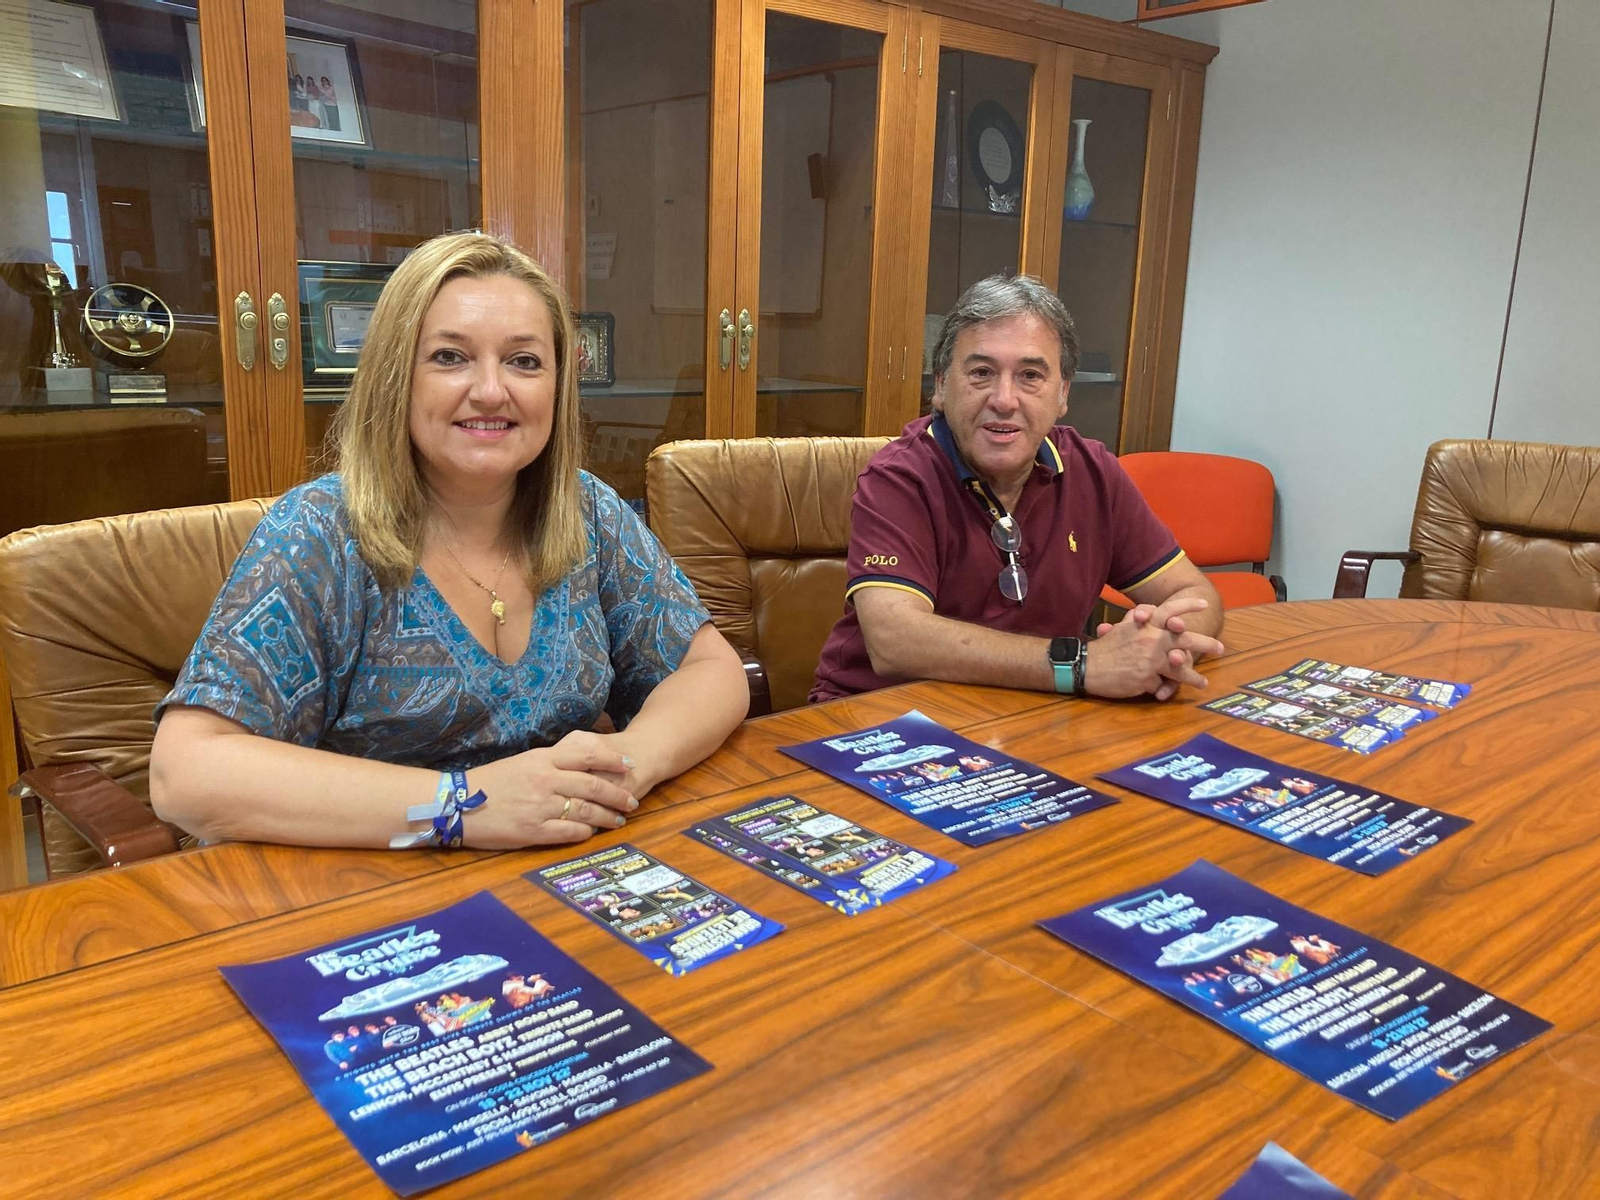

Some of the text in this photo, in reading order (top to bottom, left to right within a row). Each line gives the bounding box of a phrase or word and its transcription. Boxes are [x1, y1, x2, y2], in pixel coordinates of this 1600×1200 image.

[864, 555, 898, 566] POLO
[723, 918, 761, 937] GRAN
[1098, 893, 1194, 930] Beatles
[1140, 906, 1207, 934] Cruise
[309, 929, 442, 978] Beatles
[346, 944, 442, 982] Cruise
[680, 932, 734, 961] FESTIVAL
[1240, 1006, 1272, 1023] THE
[1263, 986, 1316, 1013] BEATLES
[1259, 1017, 1290, 1033] THE
[1281, 1000, 1325, 1024] BEACH
[1316, 987, 1353, 1007] BOYZ
[355, 1000, 578, 1086] THE BEATLES ABBEY ROAD BAND
[364, 1076, 405, 1098] THE
[404, 1053, 468, 1084] BEACH
[466, 1036, 517, 1060] BOYZ
[561, 1009, 593, 1026] BAND
[430, 1081, 465, 1101] ELVIS
[463, 1063, 512, 1087] PRESLEY
